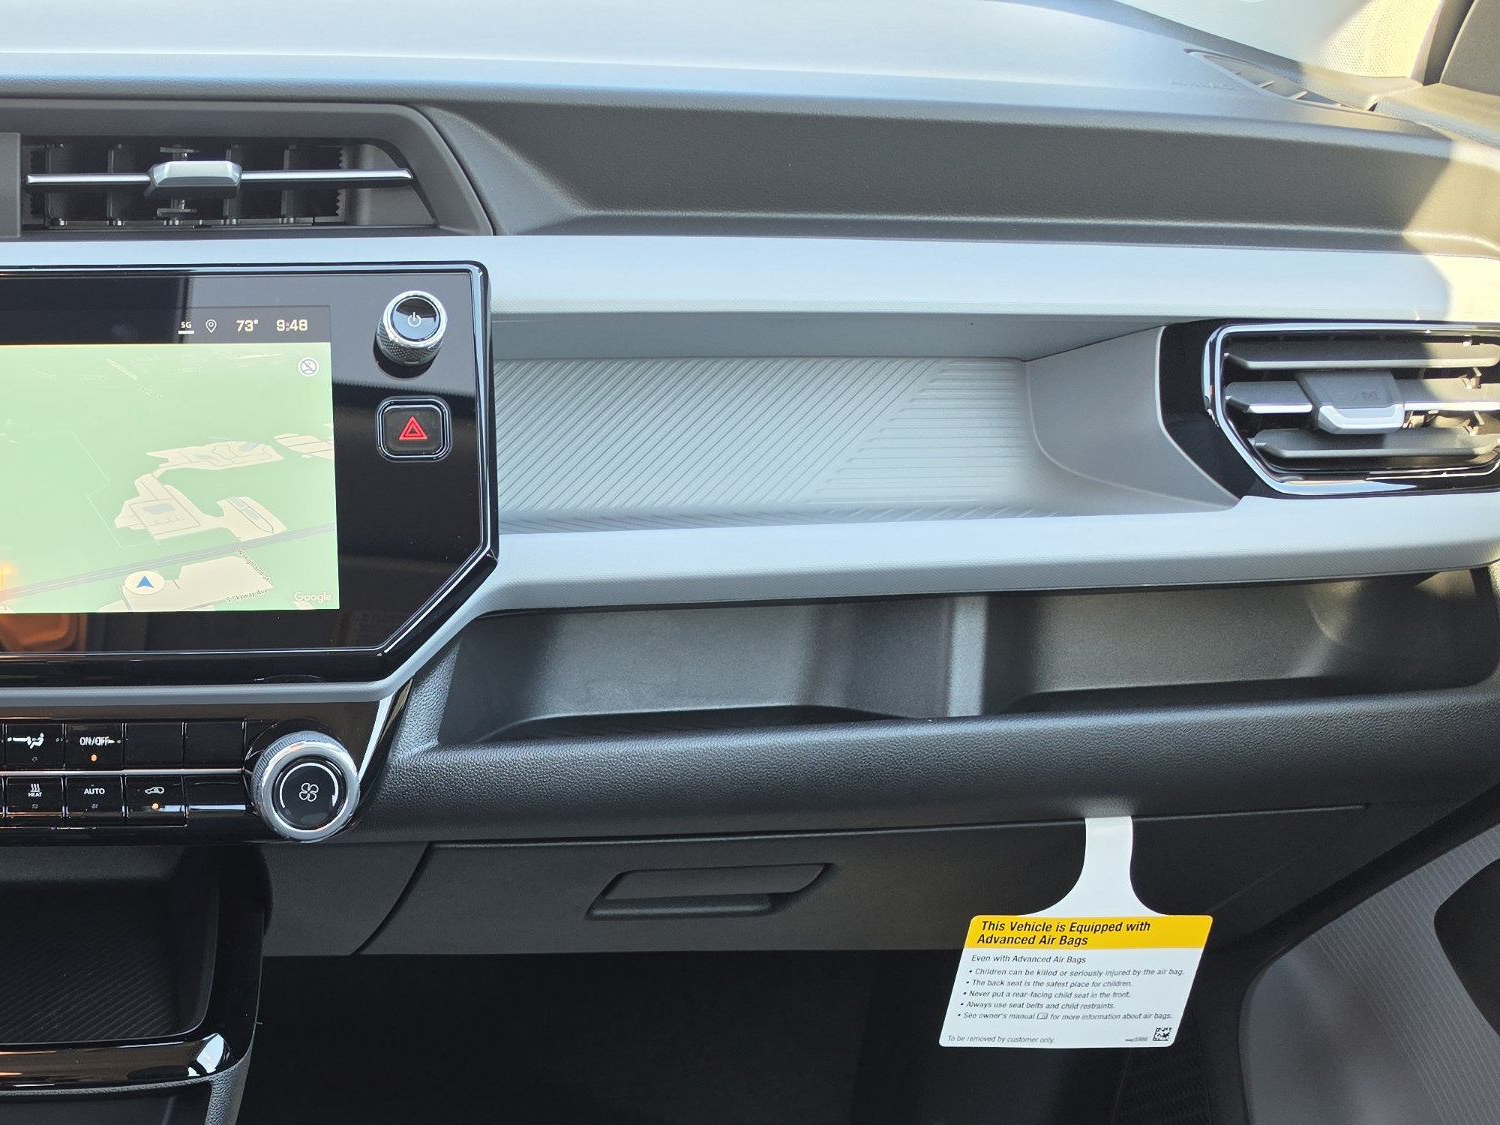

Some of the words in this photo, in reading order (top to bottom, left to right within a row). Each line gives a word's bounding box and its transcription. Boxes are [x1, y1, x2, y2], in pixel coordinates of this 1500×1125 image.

[180, 321, 192, 329] 5G
[276, 319, 308, 332] 9:48
[294, 591, 333, 603] Google
[79, 736, 110, 746] ON/OFF
[981, 920, 1005, 931] This
[1010, 921, 1052, 932] Vehicle
[1055, 922, 1066, 932] is
[1069, 921, 1123, 934] Equipped
[1126, 920, 1151, 931] with
[976, 934, 1036, 945] Advanced
[1038, 935, 1057, 945] Air
[1058, 935, 1088, 947] Bags
[971, 954, 991, 962] Even
[993, 954, 1011, 962] with
[1012, 955, 1051, 963] Advanced
[1066, 956, 1086, 964] Bags
[975, 968, 1007, 976] Children
[1069, 969, 1103, 977] seriously
[1132, 969, 1141, 977] by
[966, 1001, 992, 1009] Always
